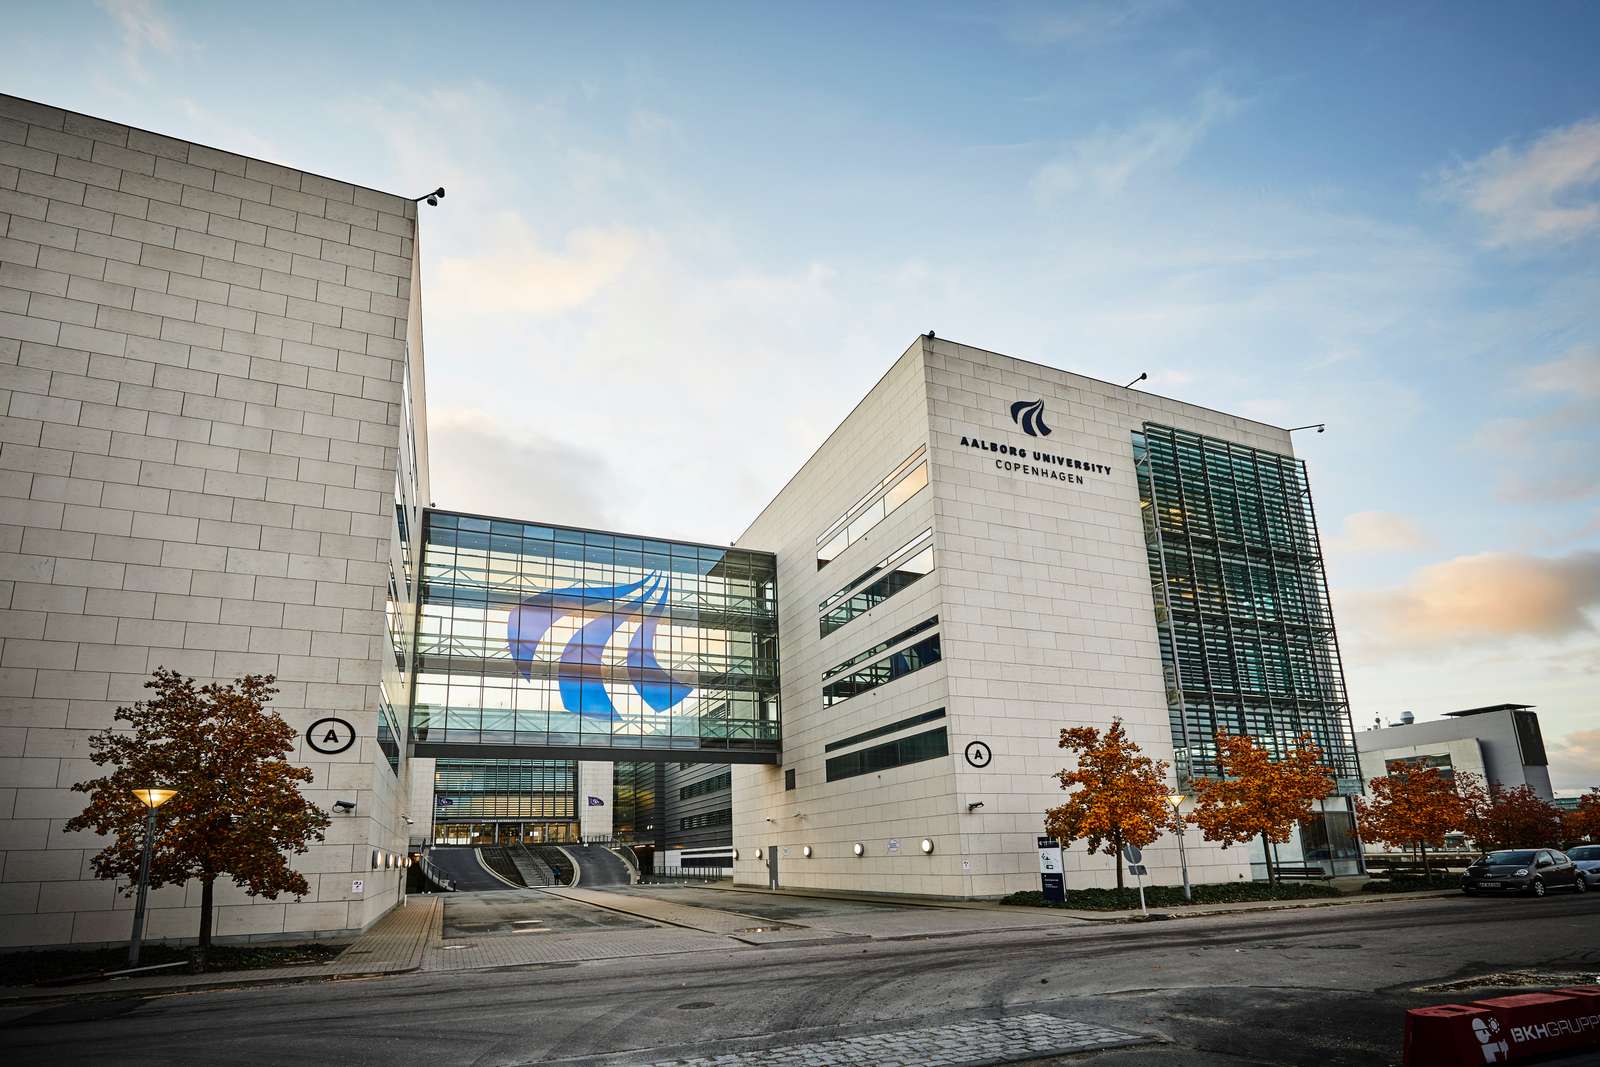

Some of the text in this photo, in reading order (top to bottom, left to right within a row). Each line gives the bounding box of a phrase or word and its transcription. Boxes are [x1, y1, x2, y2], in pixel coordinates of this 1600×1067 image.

[960, 436, 1112, 475] AALBORG UNIVERSITY
[995, 459, 1083, 485] COPENHAGEN
[322, 728, 339, 744] A
[974, 749, 984, 760] A
[1510, 1014, 1600, 1043] BKHGRUPP
